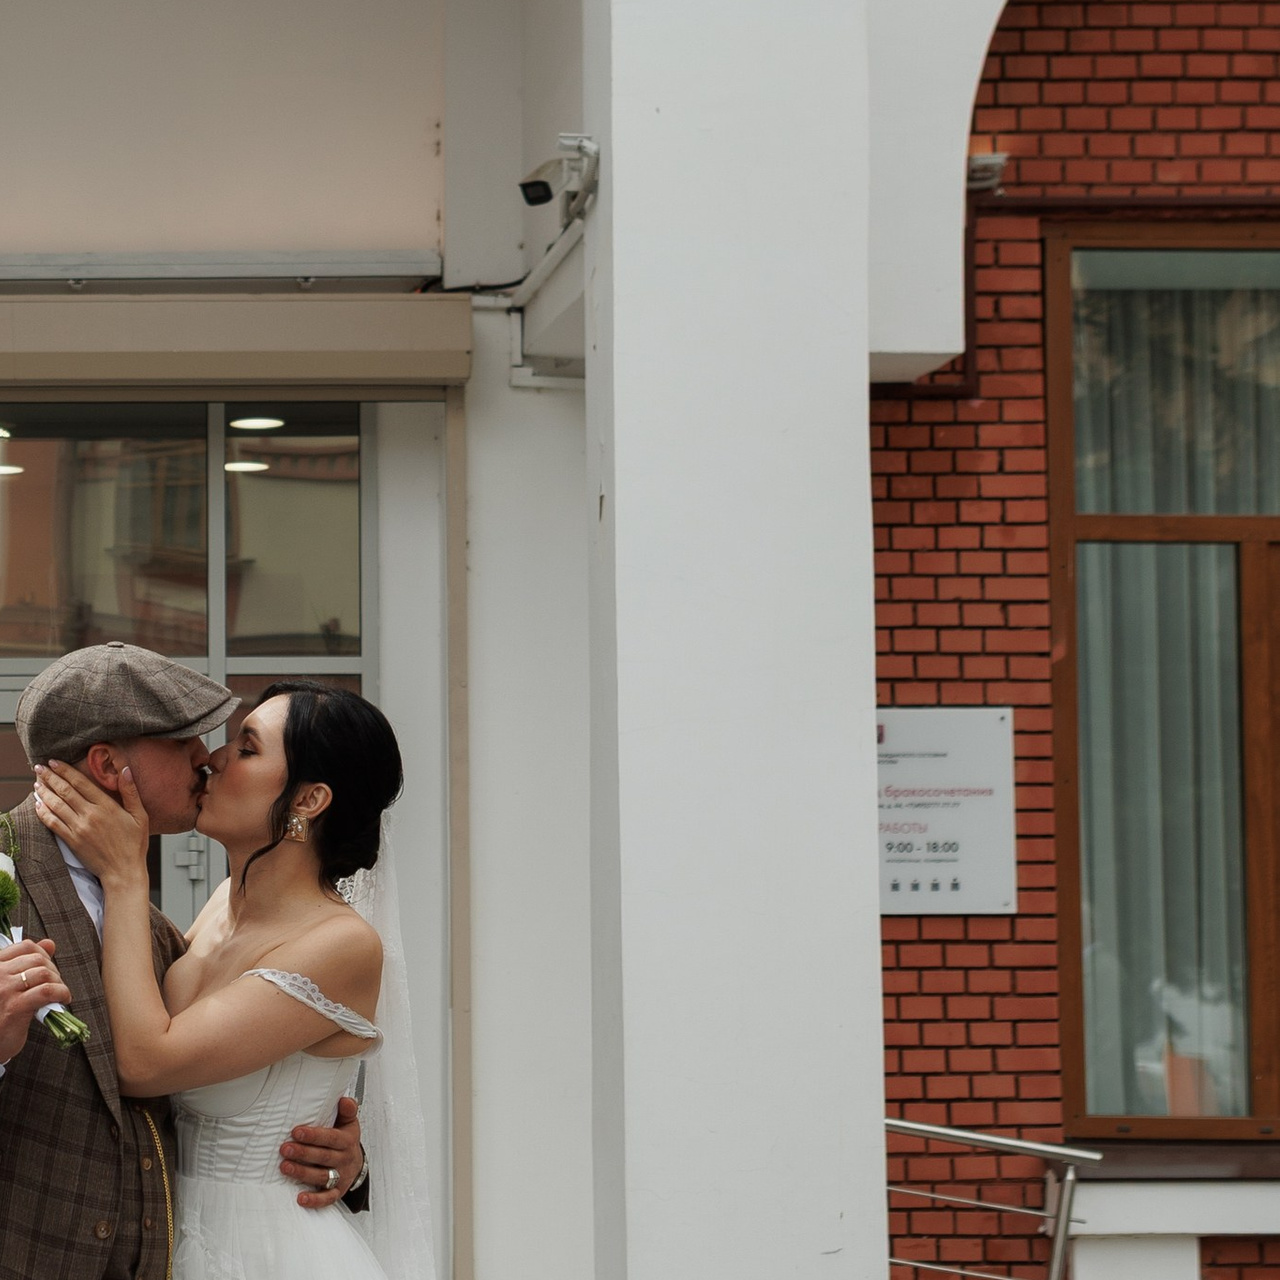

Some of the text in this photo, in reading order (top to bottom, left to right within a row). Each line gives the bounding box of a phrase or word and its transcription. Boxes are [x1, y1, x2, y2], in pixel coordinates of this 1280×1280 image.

[878, 822, 928, 835] РАБОТЫ
[885, 841, 914, 853] 9:00
[926, 841, 959, 853] 18:00
